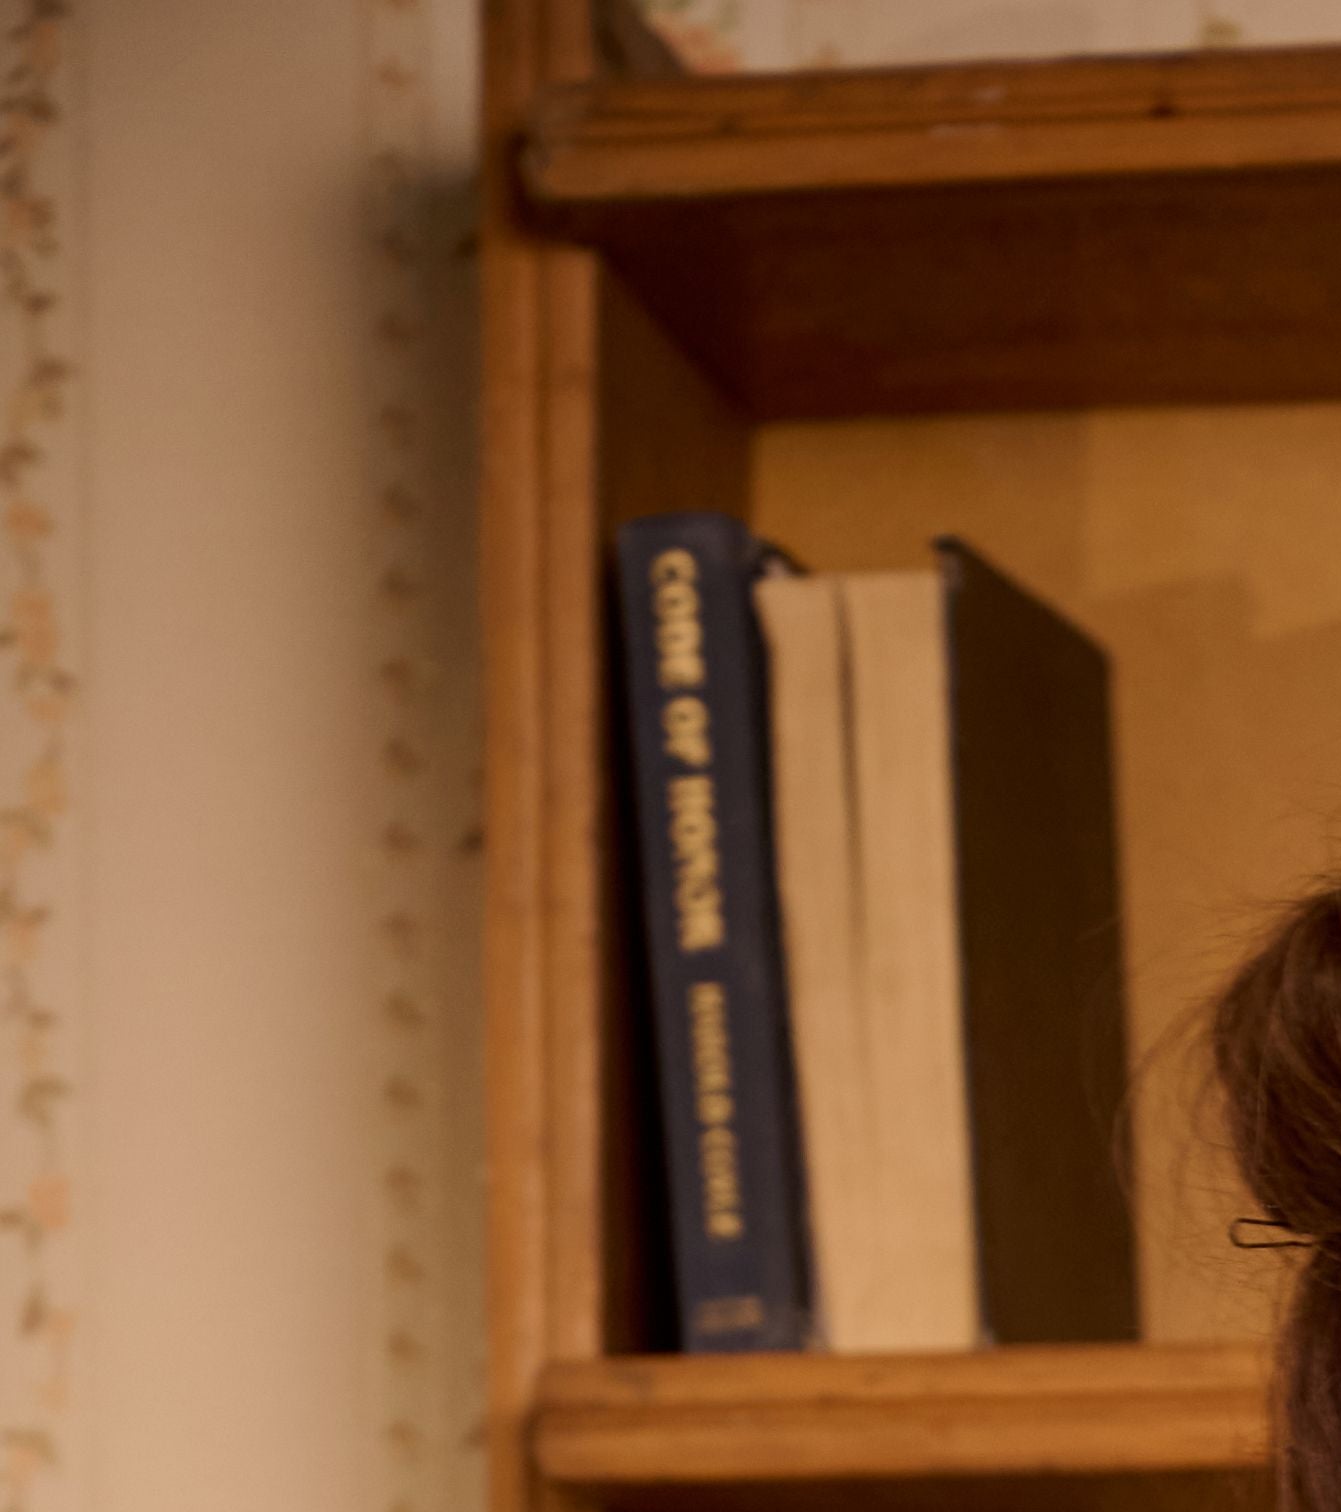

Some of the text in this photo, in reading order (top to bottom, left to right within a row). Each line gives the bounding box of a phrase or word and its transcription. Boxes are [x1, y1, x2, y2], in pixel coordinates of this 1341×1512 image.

[651, 547, 706, 689] CODE
[663, 695, 712, 781] OF
[667, 779, 726, 954] HONOR
